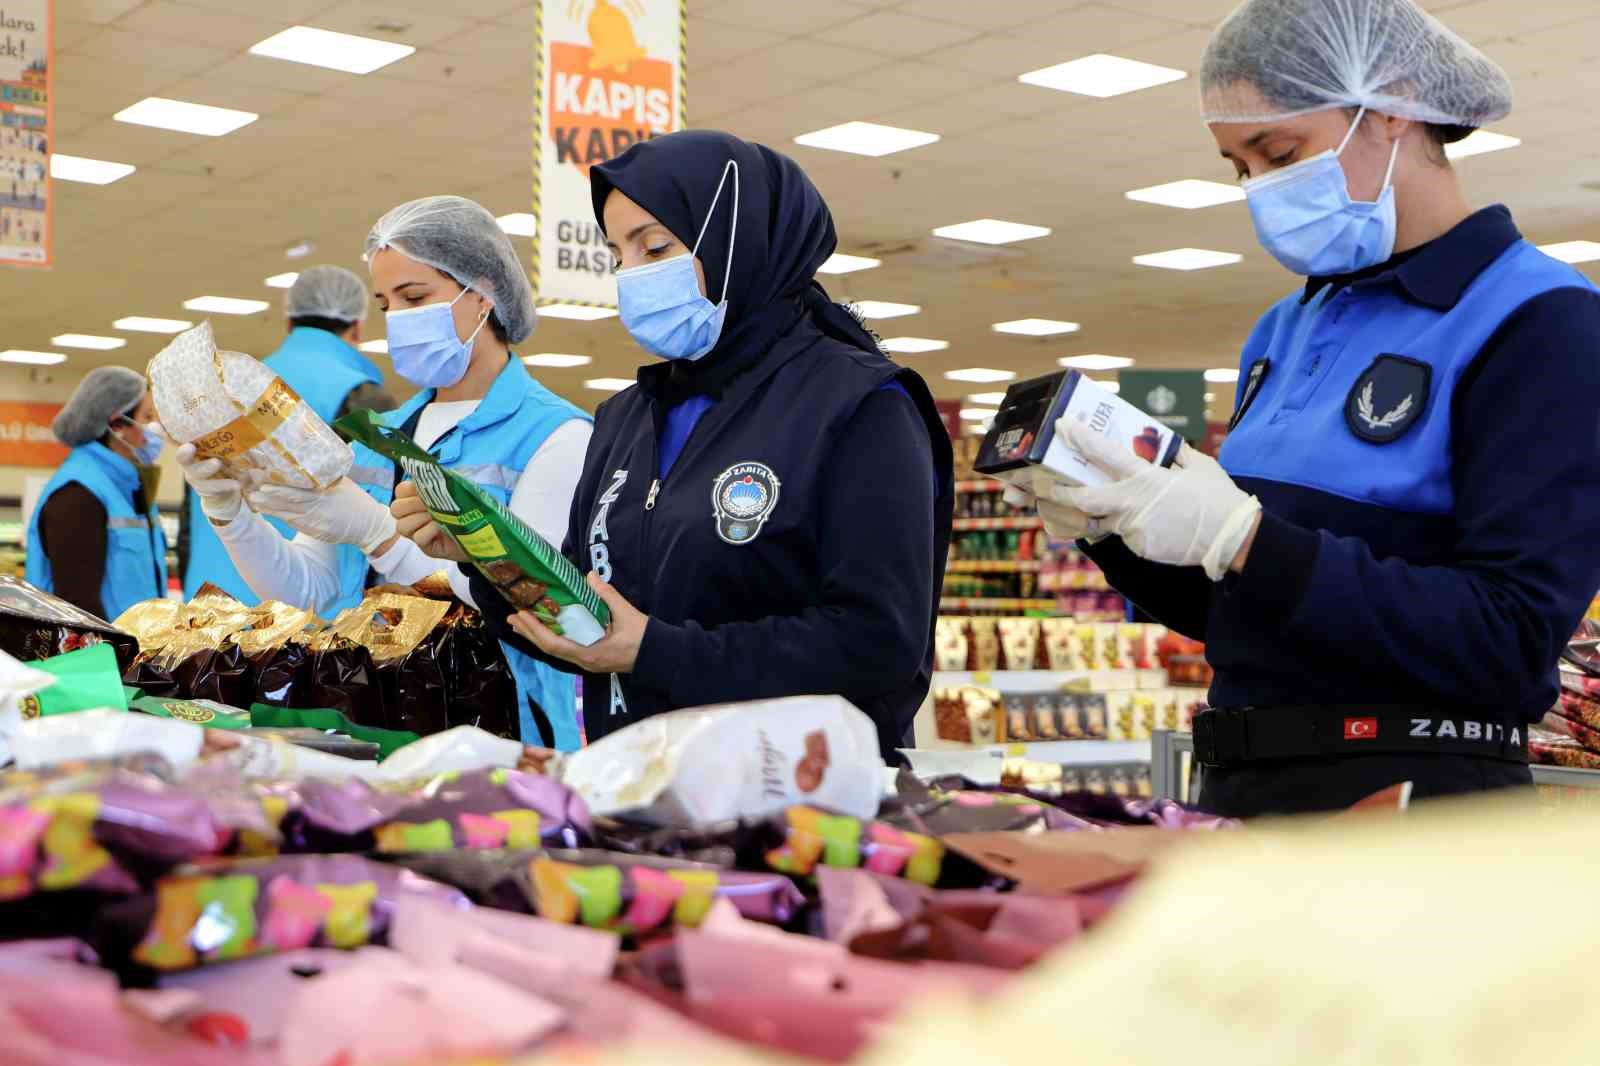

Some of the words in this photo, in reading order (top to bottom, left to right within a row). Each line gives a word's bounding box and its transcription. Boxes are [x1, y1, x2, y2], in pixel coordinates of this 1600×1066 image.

[0, 8, 36, 32] lara
[555, 127, 658, 164] KAP
[734, 466, 767, 479] ZABITA
